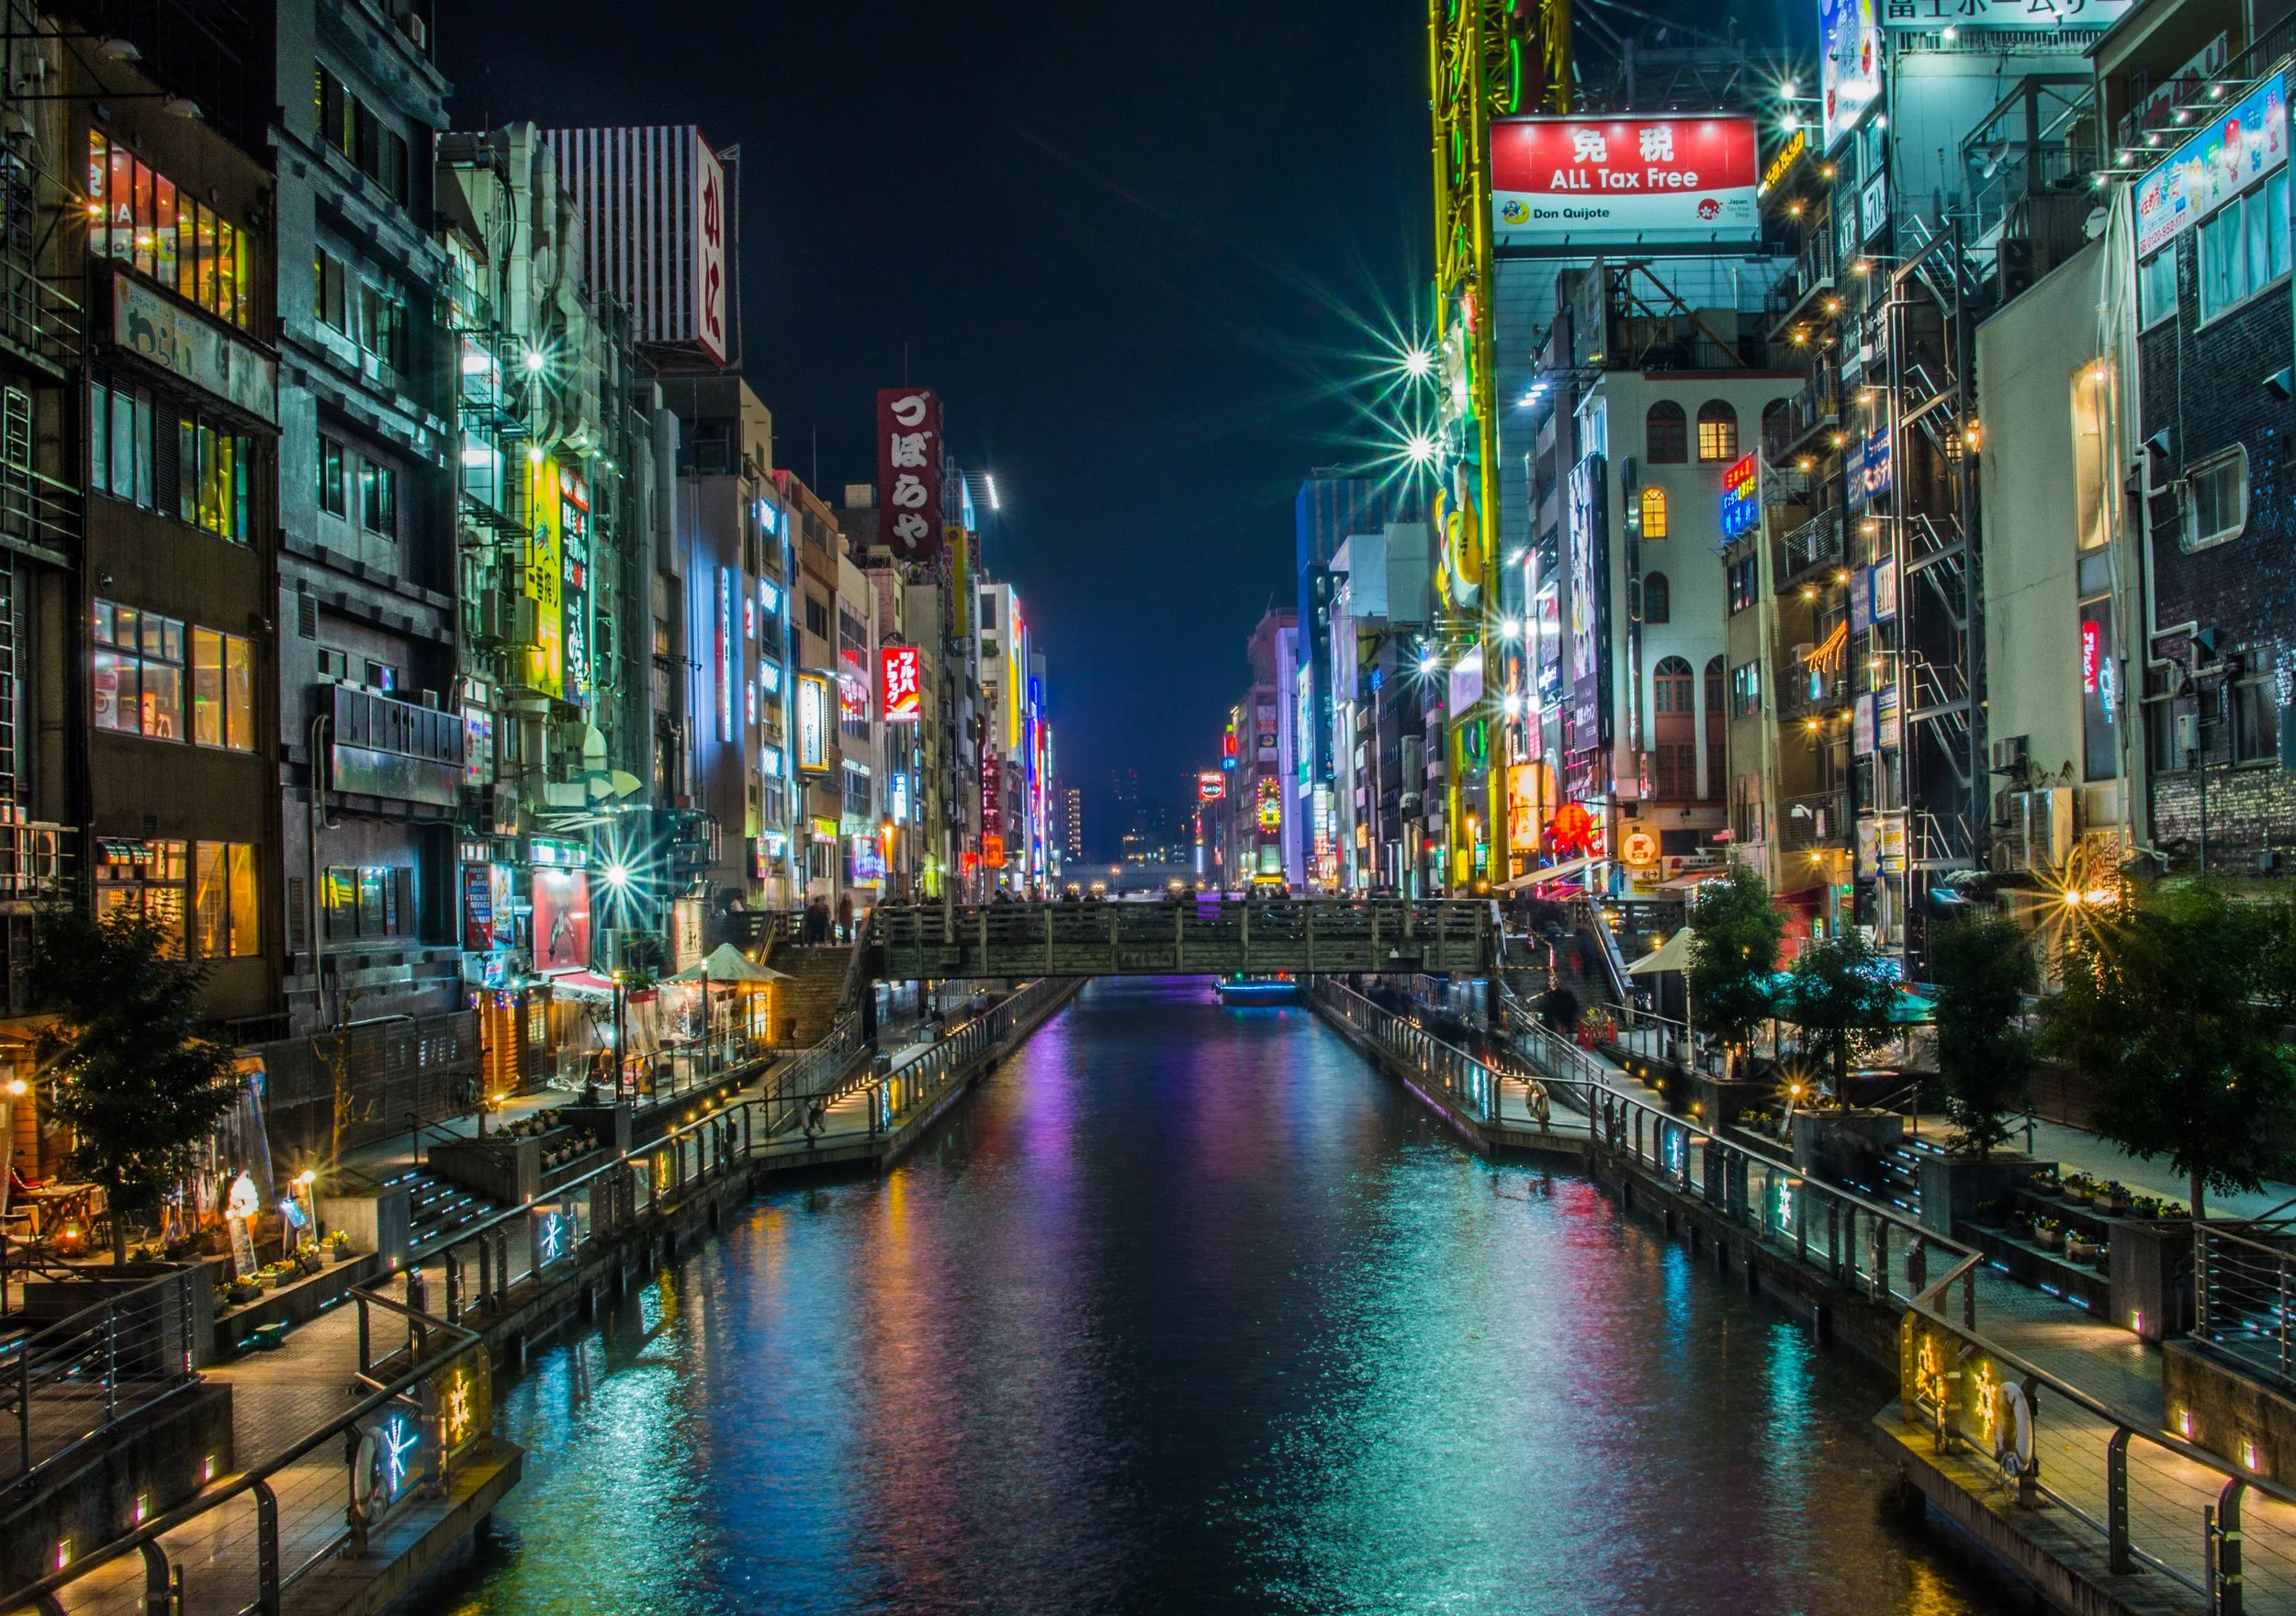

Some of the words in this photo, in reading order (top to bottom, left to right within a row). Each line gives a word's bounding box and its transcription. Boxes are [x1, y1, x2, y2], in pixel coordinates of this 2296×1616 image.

[1573, 129, 1674, 163] 免税
[1550, 169, 1591, 189] ALL
[1598, 169, 1639, 188] Tax
[1648, 168, 1699, 187] Free
[1533, 208, 1559, 219] Don
[1563, 208, 1610, 220] Quijote
[891, 391, 932, 548] づぼらや
[528, 566, 557, 608] 一番搾り
[887, 658, 901, 702] ドラッグ
[900, 652, 916, 692] ツルハ
